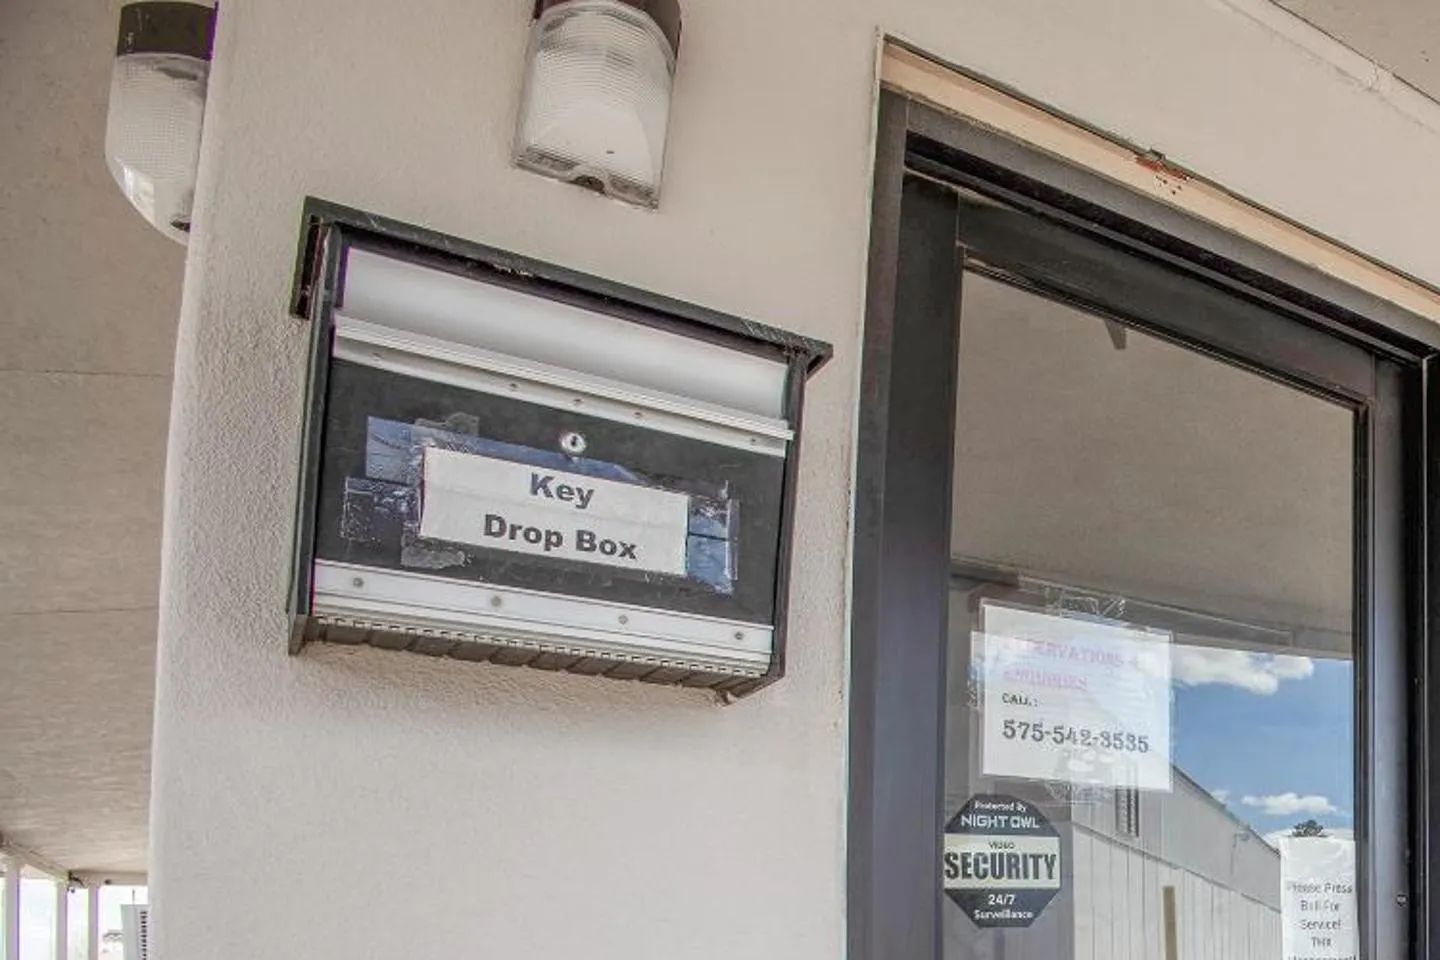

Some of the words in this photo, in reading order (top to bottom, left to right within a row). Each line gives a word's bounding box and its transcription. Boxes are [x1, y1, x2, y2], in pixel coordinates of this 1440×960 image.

[530, 472, 595, 509] Key
[483, 513, 564, 551] Drop
[575, 529, 638, 560] Box
[1002, 719, 1149, 753] 575-542-3535
[961, 815, 1010, 827] NIGHT
[1011, 815, 1040, 828] OWL
[944, 851, 1057, 880] SECURITY
[974, 909, 1033, 919] Surveillance
[988, 894, 1016, 905] 24/7
